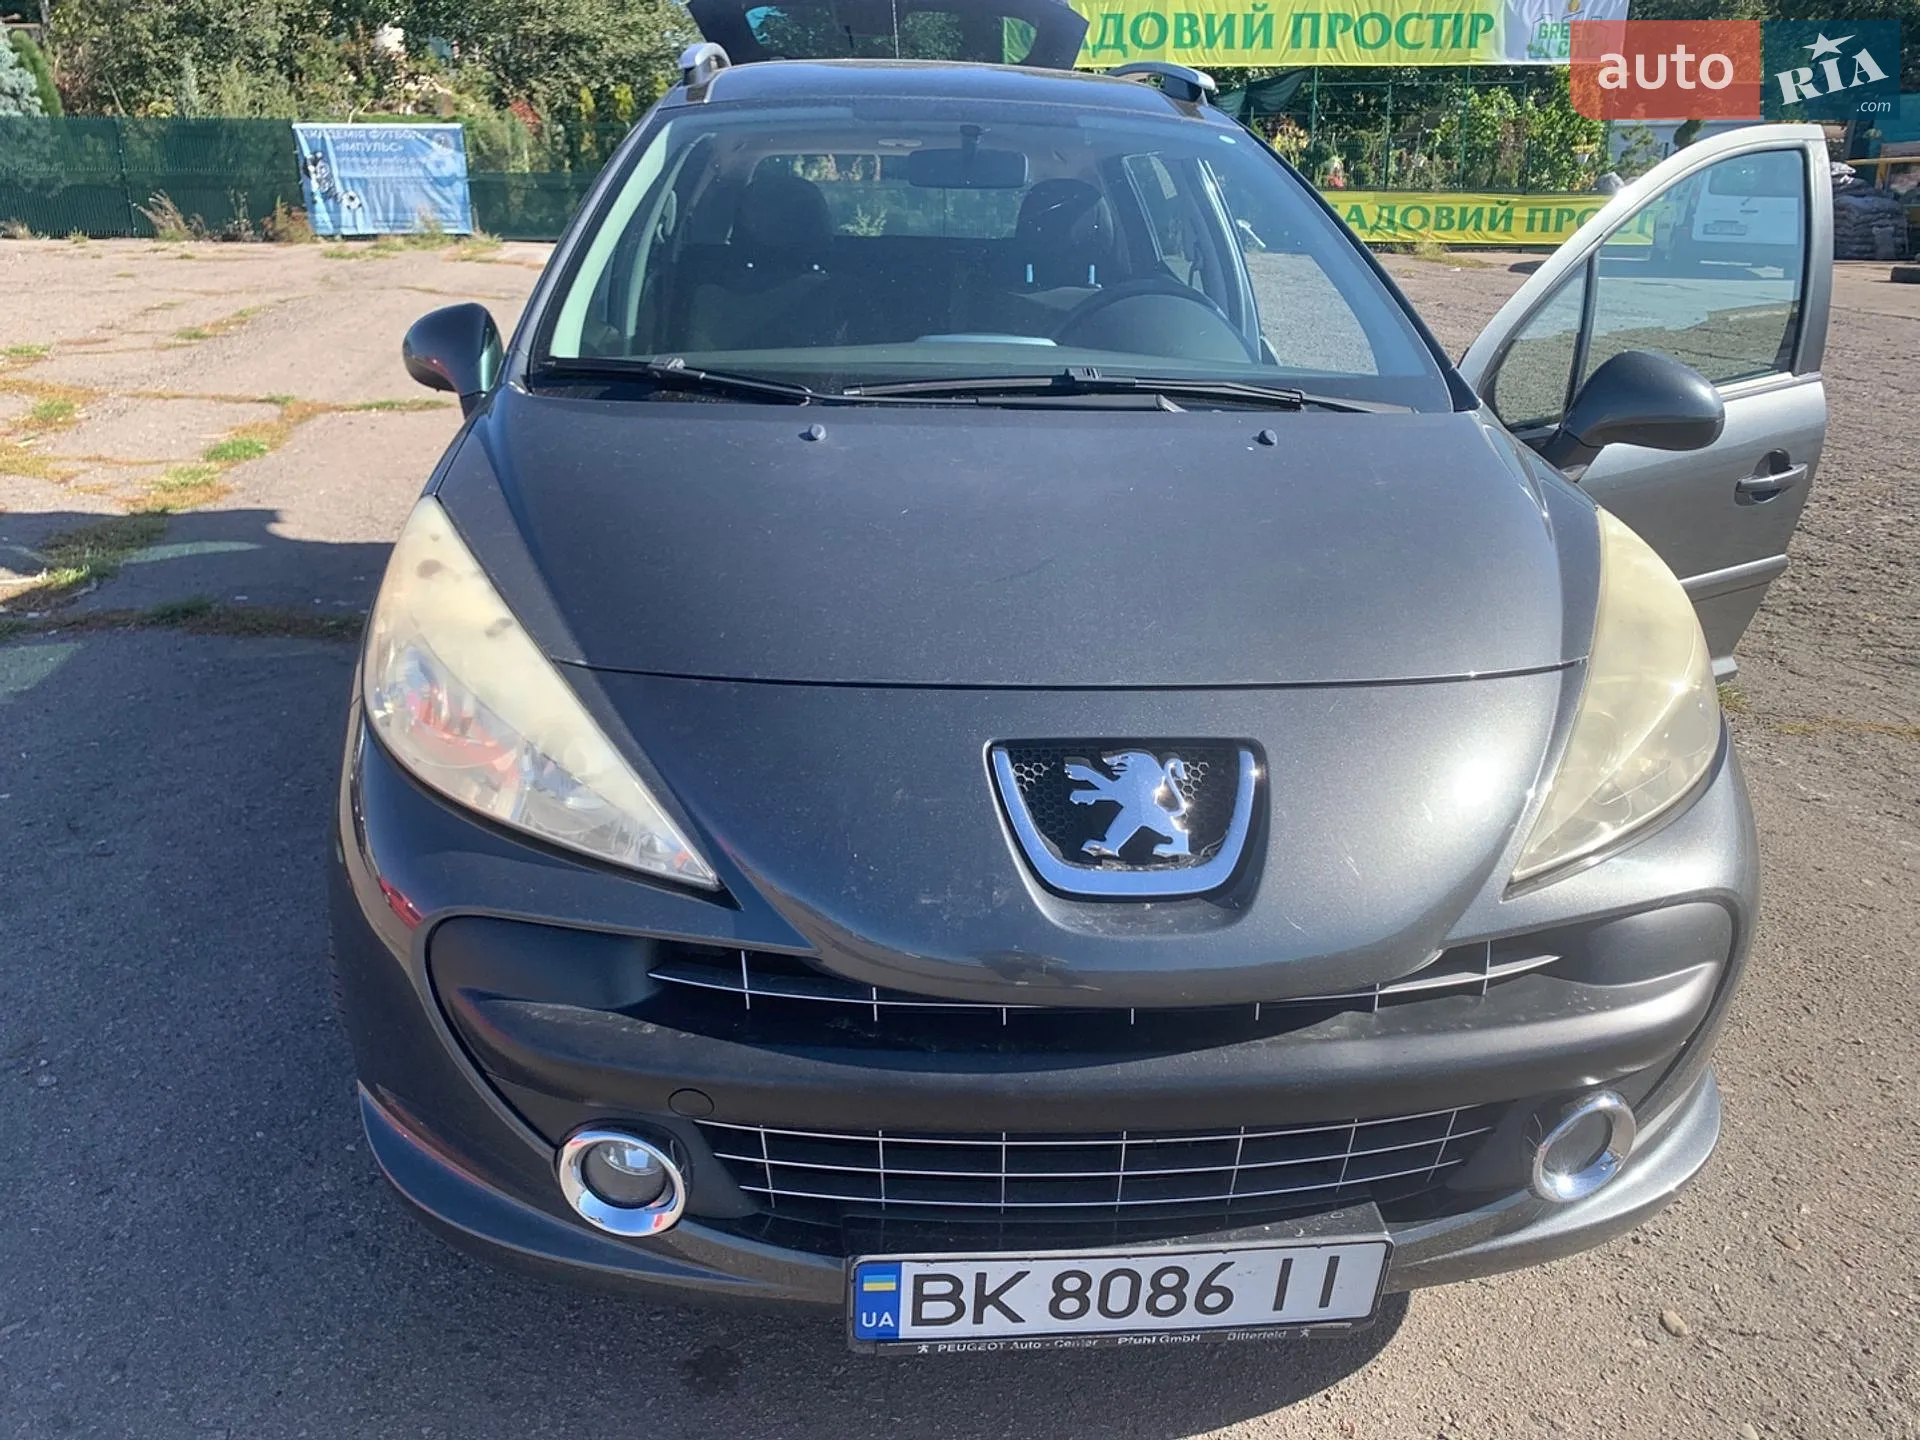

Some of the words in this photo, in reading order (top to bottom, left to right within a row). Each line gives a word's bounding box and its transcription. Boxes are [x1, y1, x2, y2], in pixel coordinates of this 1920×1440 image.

[1291, 11, 1495, 50] ПРОСТІР
[910, 1270, 1031, 1327] BK
[1048, 1261, 1236, 1320] 8086
[861, 1311, 895, 1328] UA
[937, 1342, 1005, 1353] PEUGEOT
[1010, 1340, 1042, 1350] Auto
[1159, 1333, 1201, 1344] GmbH
